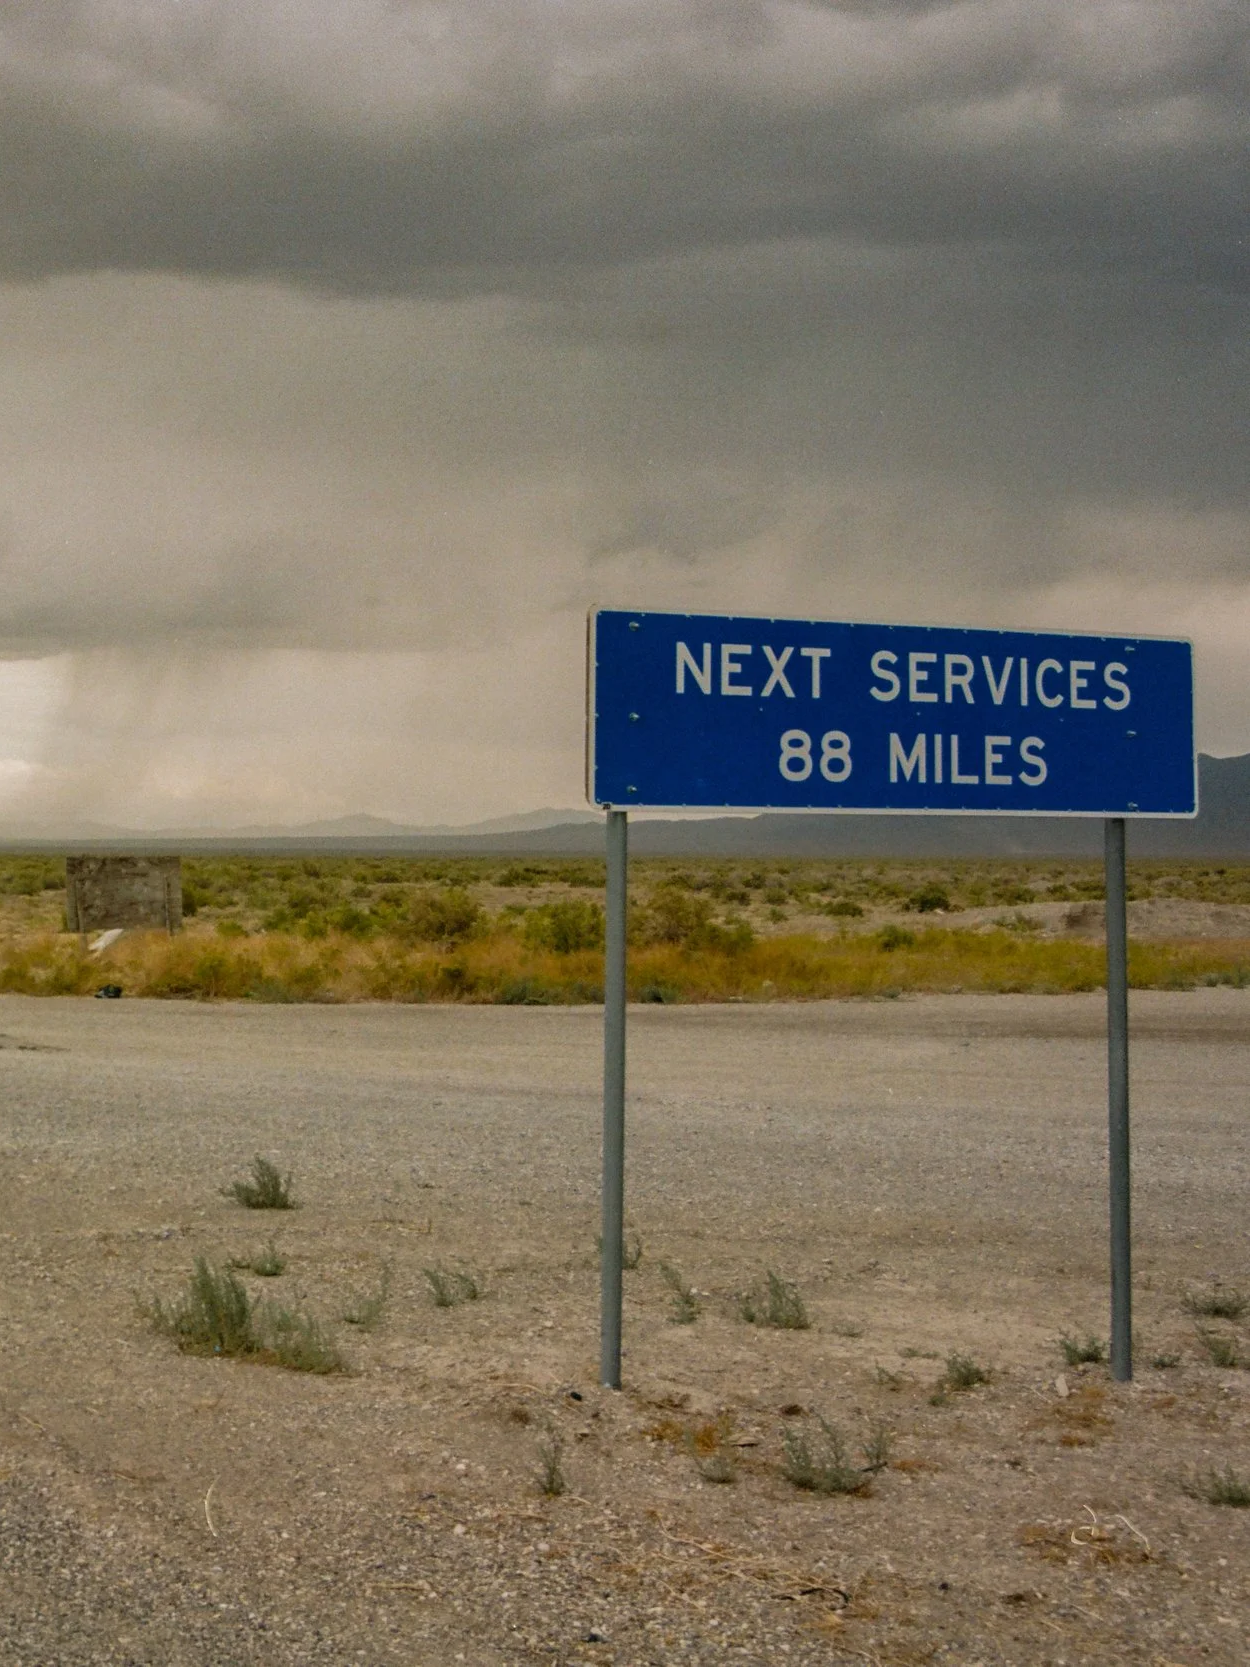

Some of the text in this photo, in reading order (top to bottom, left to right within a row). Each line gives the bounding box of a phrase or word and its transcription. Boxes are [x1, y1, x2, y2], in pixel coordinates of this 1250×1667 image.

[676, 641, 1131, 711] NEXT SERVICES
[779, 729, 1047, 786] 88 MILES
